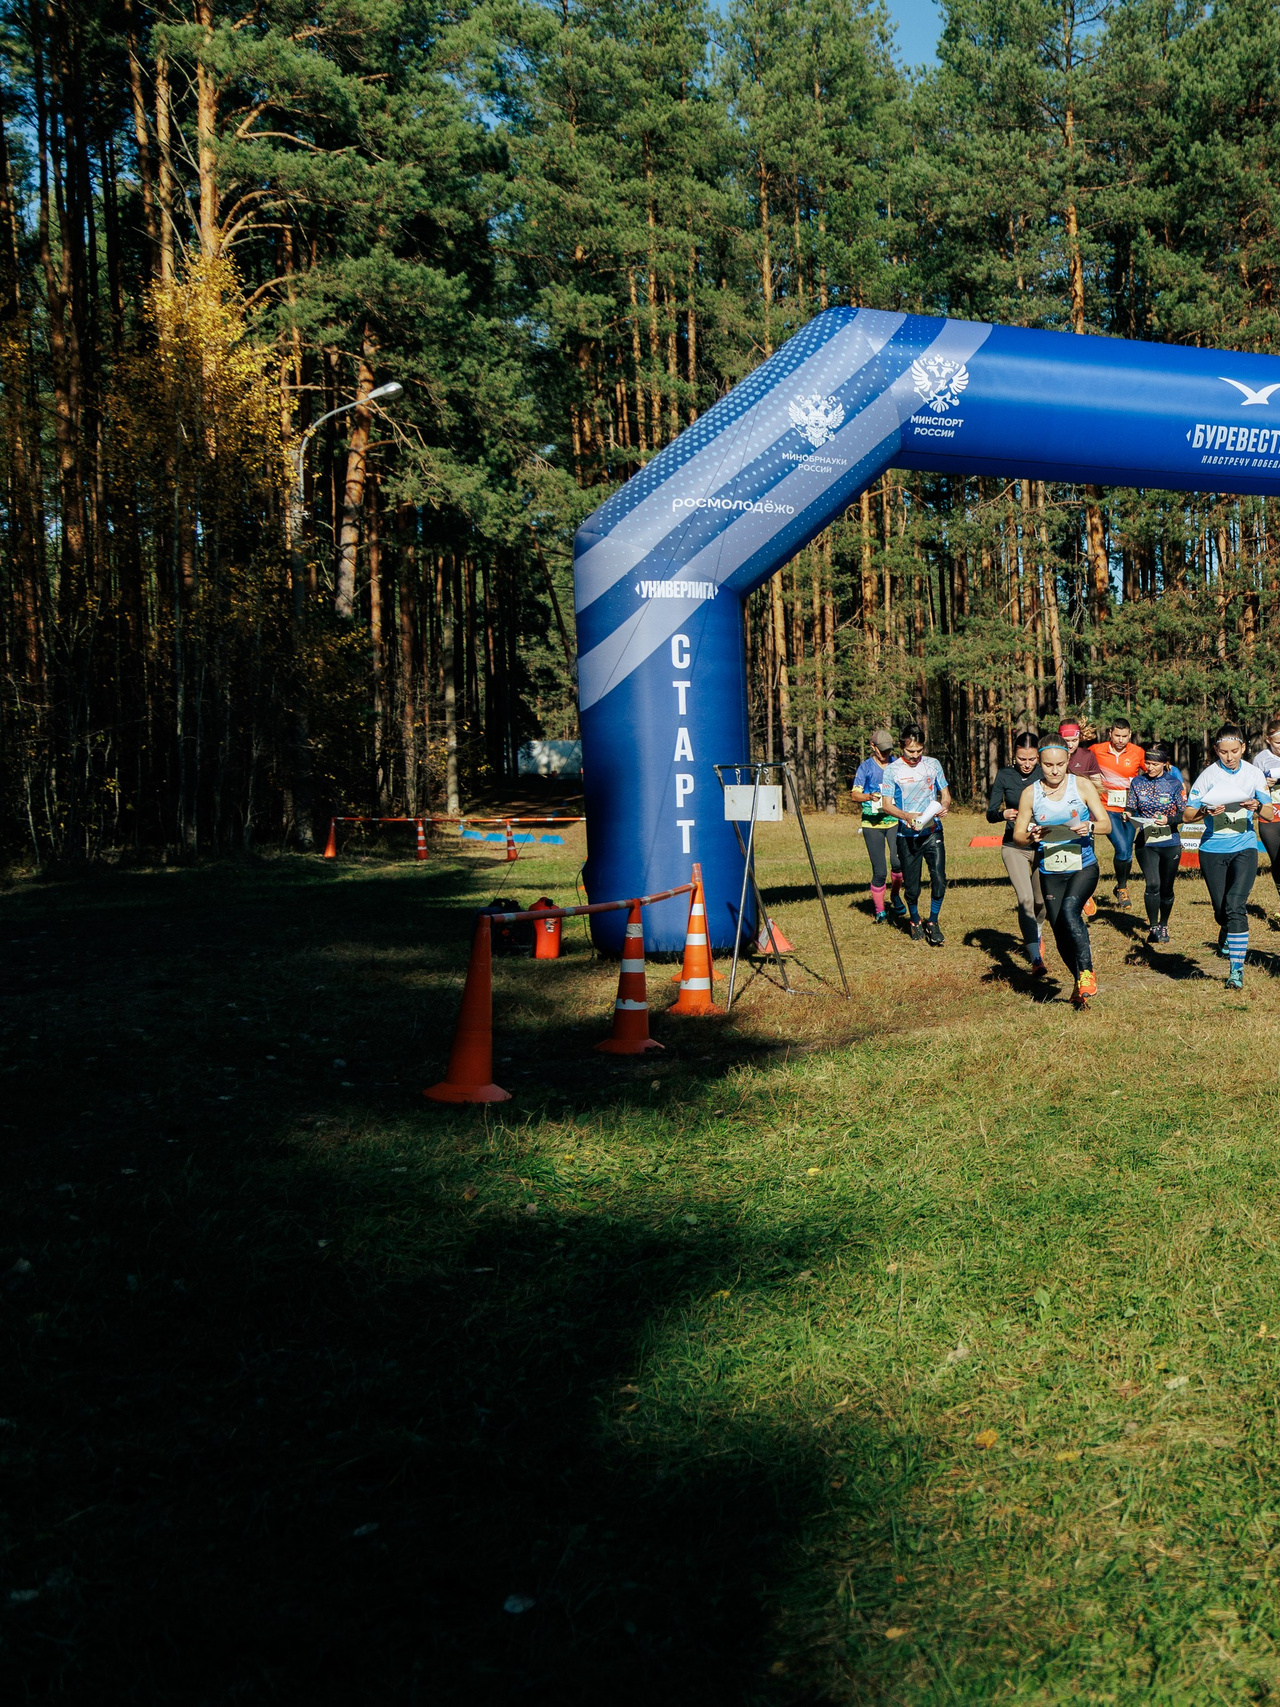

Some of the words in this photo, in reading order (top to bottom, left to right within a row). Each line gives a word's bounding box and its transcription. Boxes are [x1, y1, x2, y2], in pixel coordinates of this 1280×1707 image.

[910, 415, 964, 428] МИНСПОРТ
[914, 427, 955, 438] РОССИИ
[781, 452, 848, 466] МИНОБРНАУКИ
[1201, 455, 1251, 467] НАВСТРЕЧУ
[798, 463, 833, 474] РОССИИ
[671, 497, 796, 515] росмолодёжь
[639, 580, 715, 600] УНИВЕРЛИГА
[671, 634, 696, 854] СТАРТ
[1224, 816, 1236, 826] 3.1
[1054, 854, 1068, 864] 2.1
